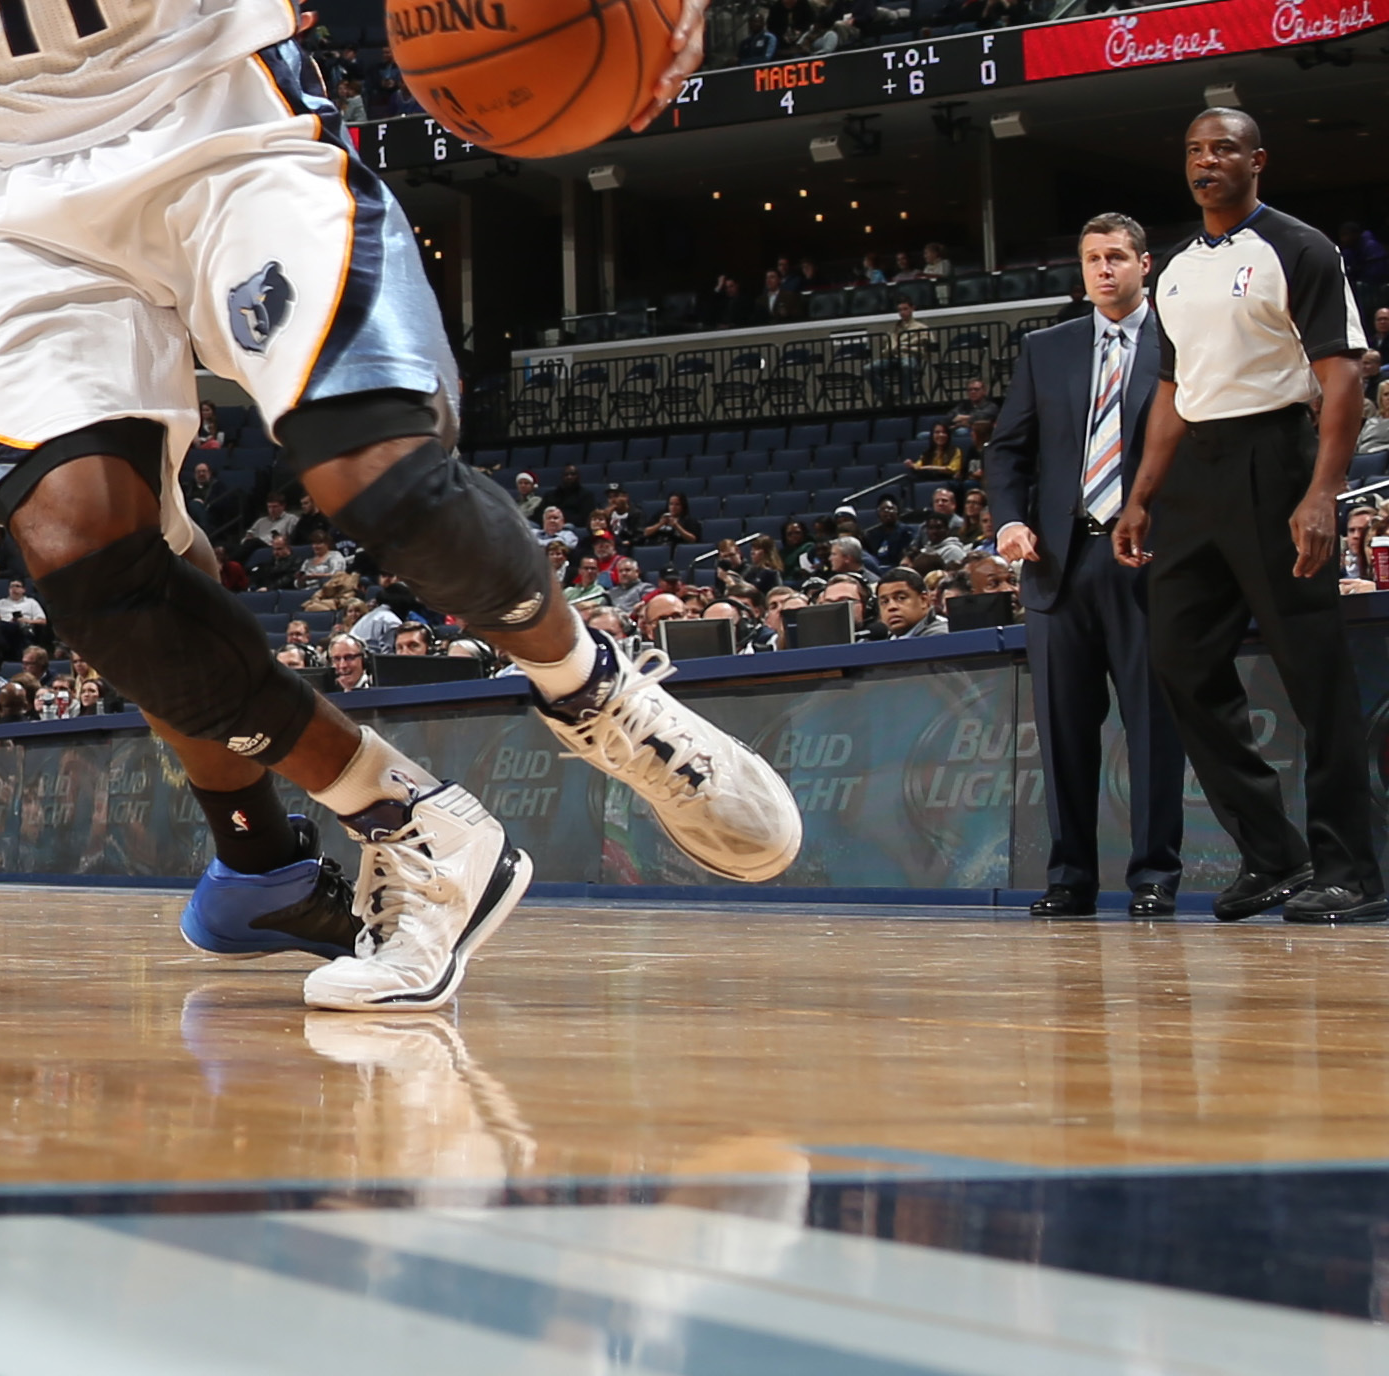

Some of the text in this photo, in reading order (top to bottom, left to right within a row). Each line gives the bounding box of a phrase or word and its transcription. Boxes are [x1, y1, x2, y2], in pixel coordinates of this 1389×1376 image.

[754, 61, 826, 91] MAGIC
[983, 35, 995, 54] F
[780, 90, 795, 115] 4
[981, 60, 997, 85] 0
[377, 124, 388, 141] F
[378, 138, 447, 168] 1 6
[773, 729, 854, 770] BUD
[947, 718, 1040, 762] BUD
[490, 748, 553, 782] BUD
